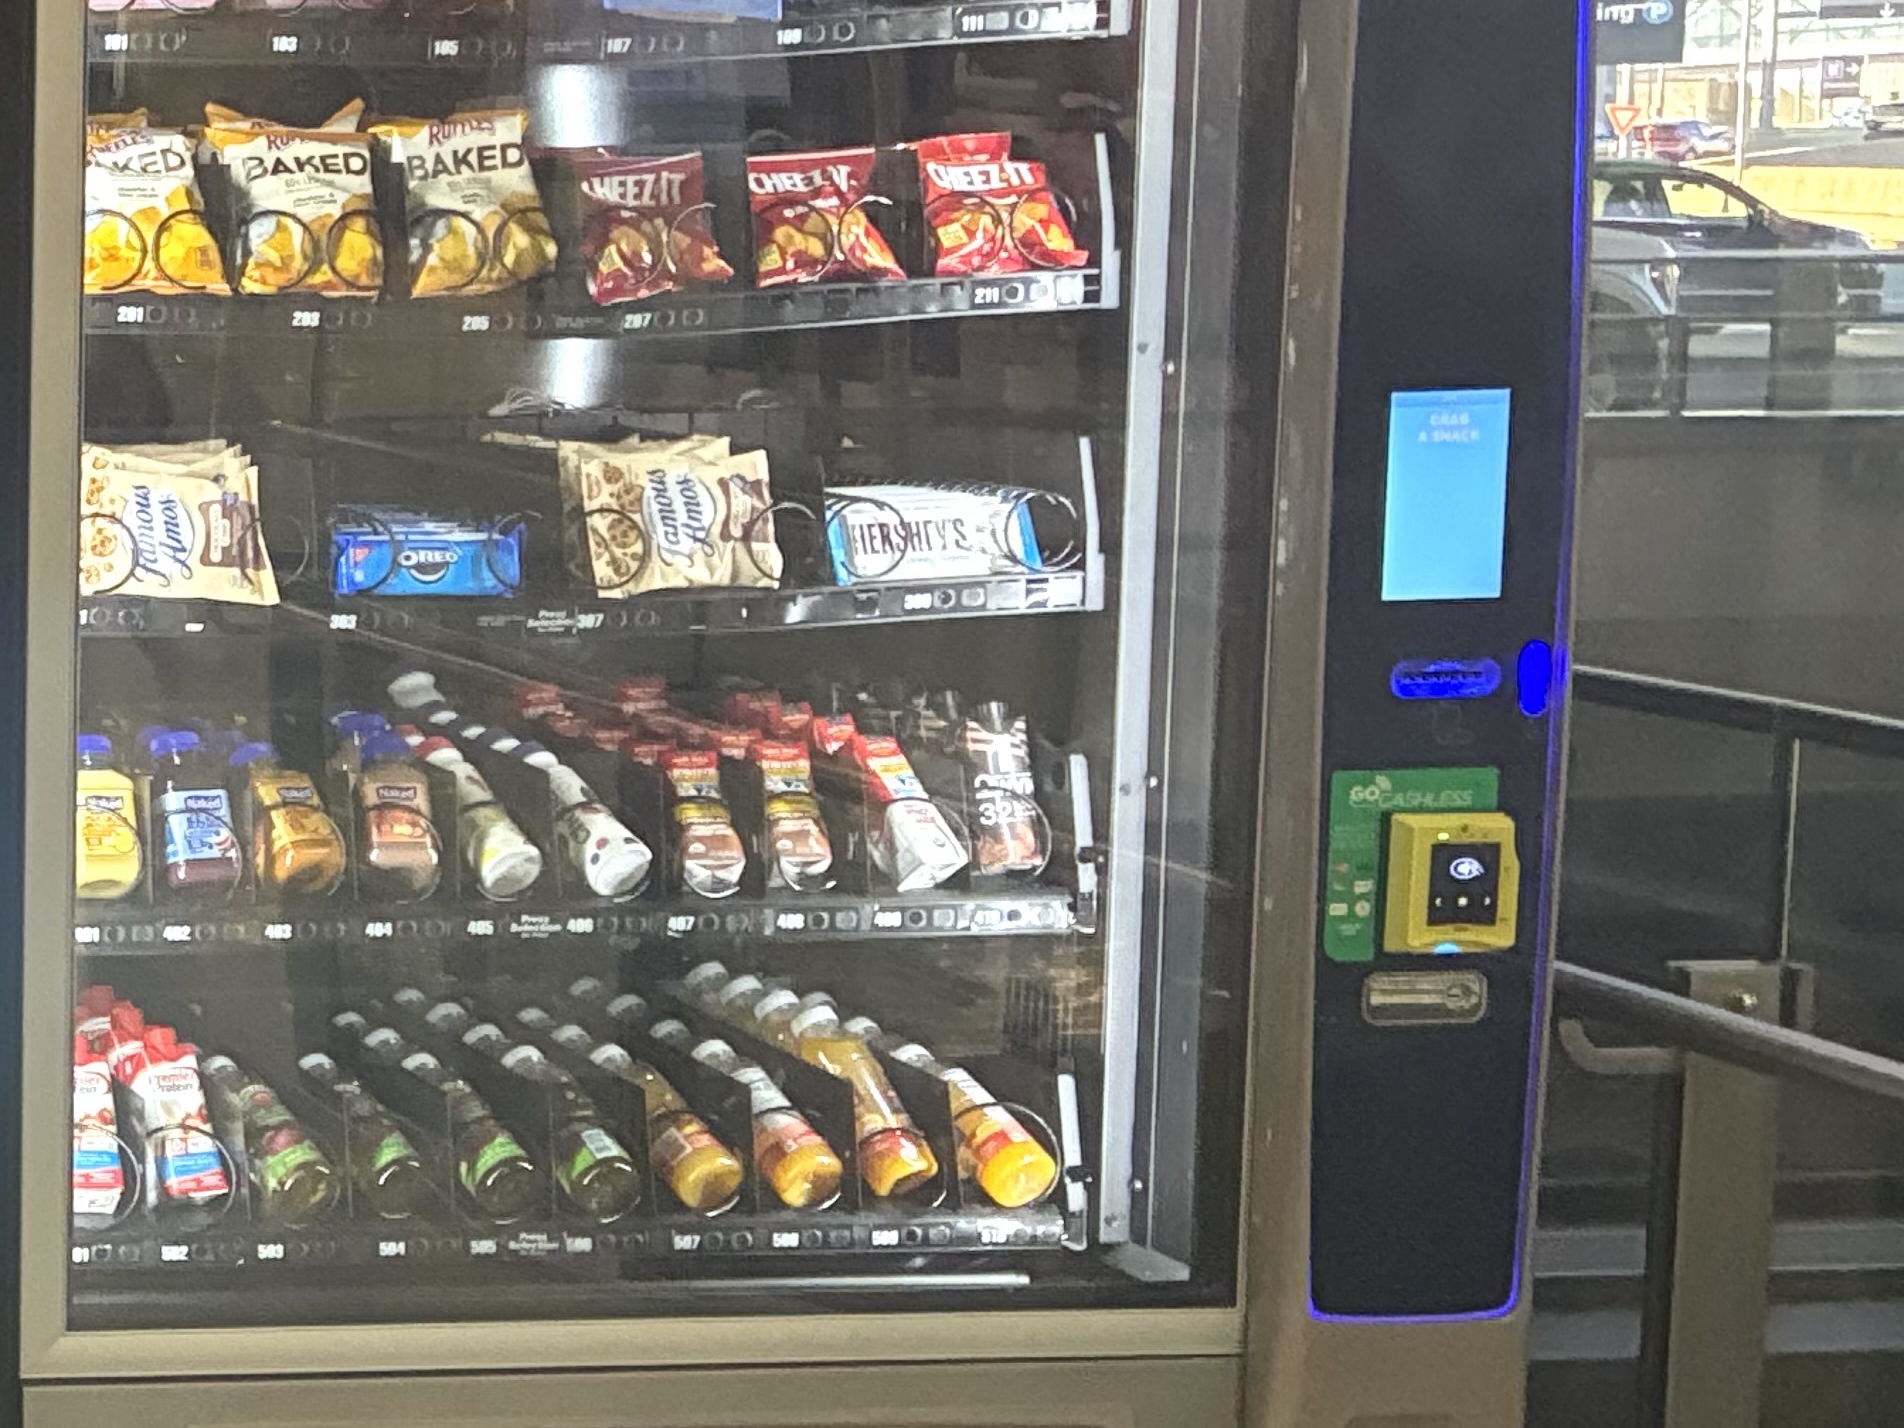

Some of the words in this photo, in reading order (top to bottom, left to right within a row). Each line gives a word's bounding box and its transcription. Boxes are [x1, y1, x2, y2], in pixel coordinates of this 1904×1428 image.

[961, 14, 986, 32] 111
[104, 33, 129, 52] 101
[272, 35, 298, 53] 103
[433, 38, 459, 56] 105
[606, 37, 632, 55] 107
[240, 151, 369, 183] BAKED
[405, 141, 525, 181] BAKED
[926, 160, 1036, 193] CHEEZ-IT
[974, 287, 999, 305] 211
[117, 306, 144, 324] 201
[292, 309, 320, 327] 203
[461, 315, 490, 333] 205
[623, 312, 651, 330] 207
[1417, 431, 1428, 442] A
[647, 467, 680, 568] Famous
[678, 473, 715, 568] Amos
[134, 484, 155, 584] Famous
[160, 494, 193, 587] Amos
[848, 518, 969, 557] HERSHEY'S
[398, 546, 459, 569] OREO
[330, 614, 357, 629] 303
[378, 786, 415, 800] Naked
[1349, 785, 1381, 803] GO
[1378, 789, 1473, 809] CASHLESS
[163, 924, 192, 941] 402
[264, 923, 293, 940] 403
[365, 921, 392, 937] 404
[467, 919, 494, 935] 405
[667, 915, 695, 932] 407
[378, 1240, 406, 1257] 504
[470, 1238, 497, 1255] 505
[673, 1232, 701, 1250] 507
[160, 1243, 189, 1262] 502
[257, 1243, 285, 1260] 503
